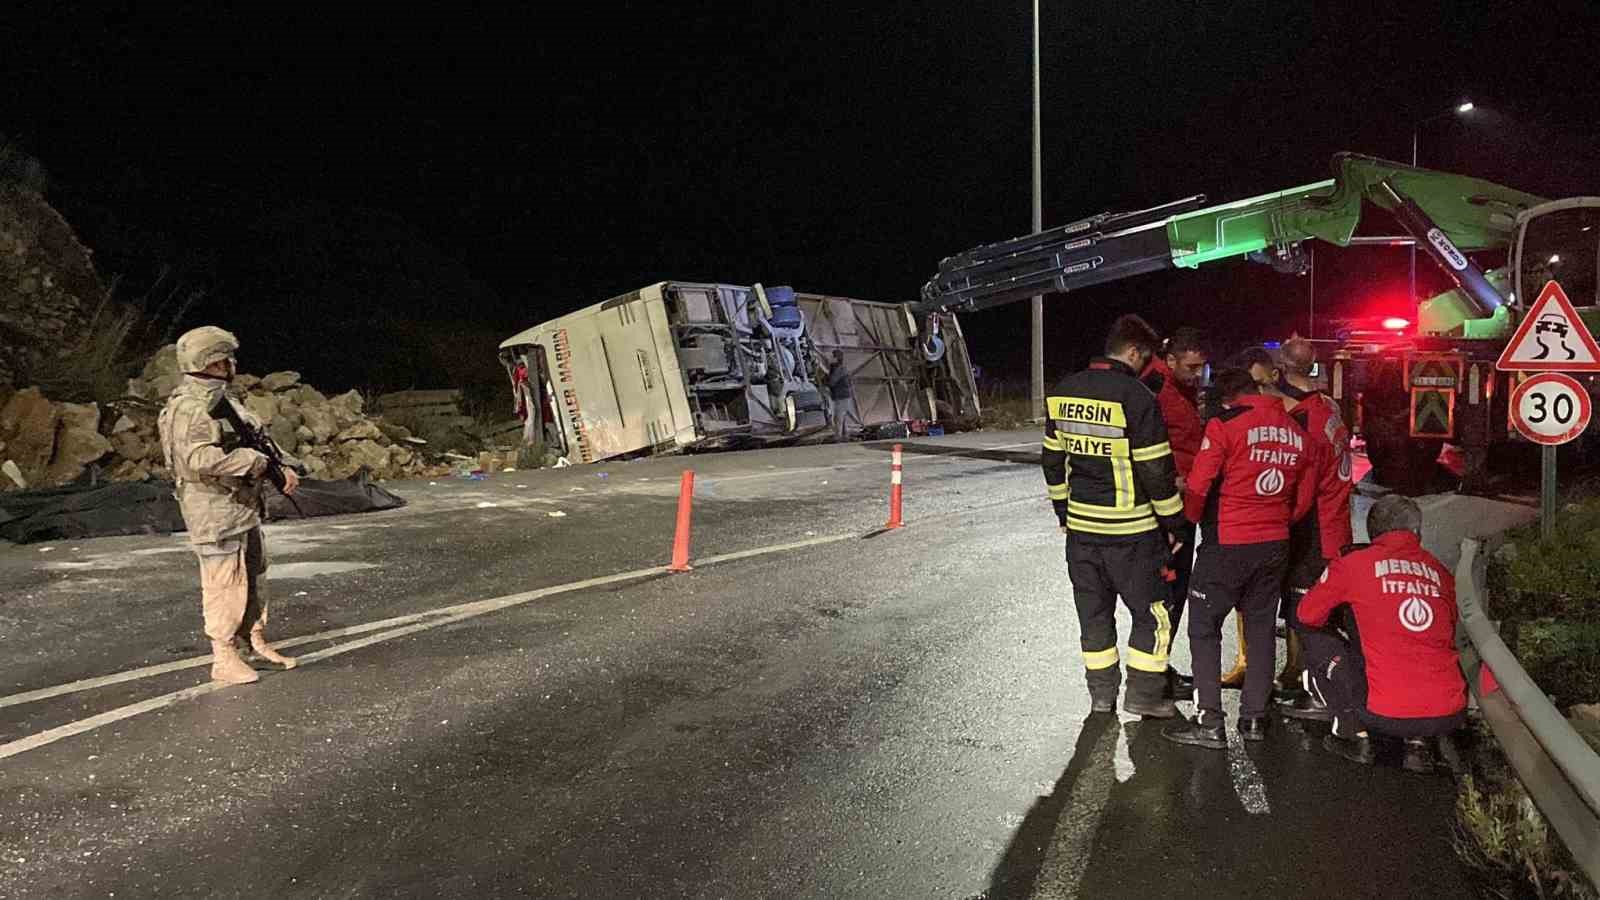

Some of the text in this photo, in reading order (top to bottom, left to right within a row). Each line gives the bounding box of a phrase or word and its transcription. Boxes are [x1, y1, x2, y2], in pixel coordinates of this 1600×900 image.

[1059, 402, 1112, 423] MERSİN
[1528, 393, 1573, 424] 30
[1248, 426, 1303, 451] MERSİN
[1250, 447, 1298, 466] İTFAİYE
[1375, 559, 1441, 587] MERSİN
[1382, 577, 1441, 597] İTFAİYE
